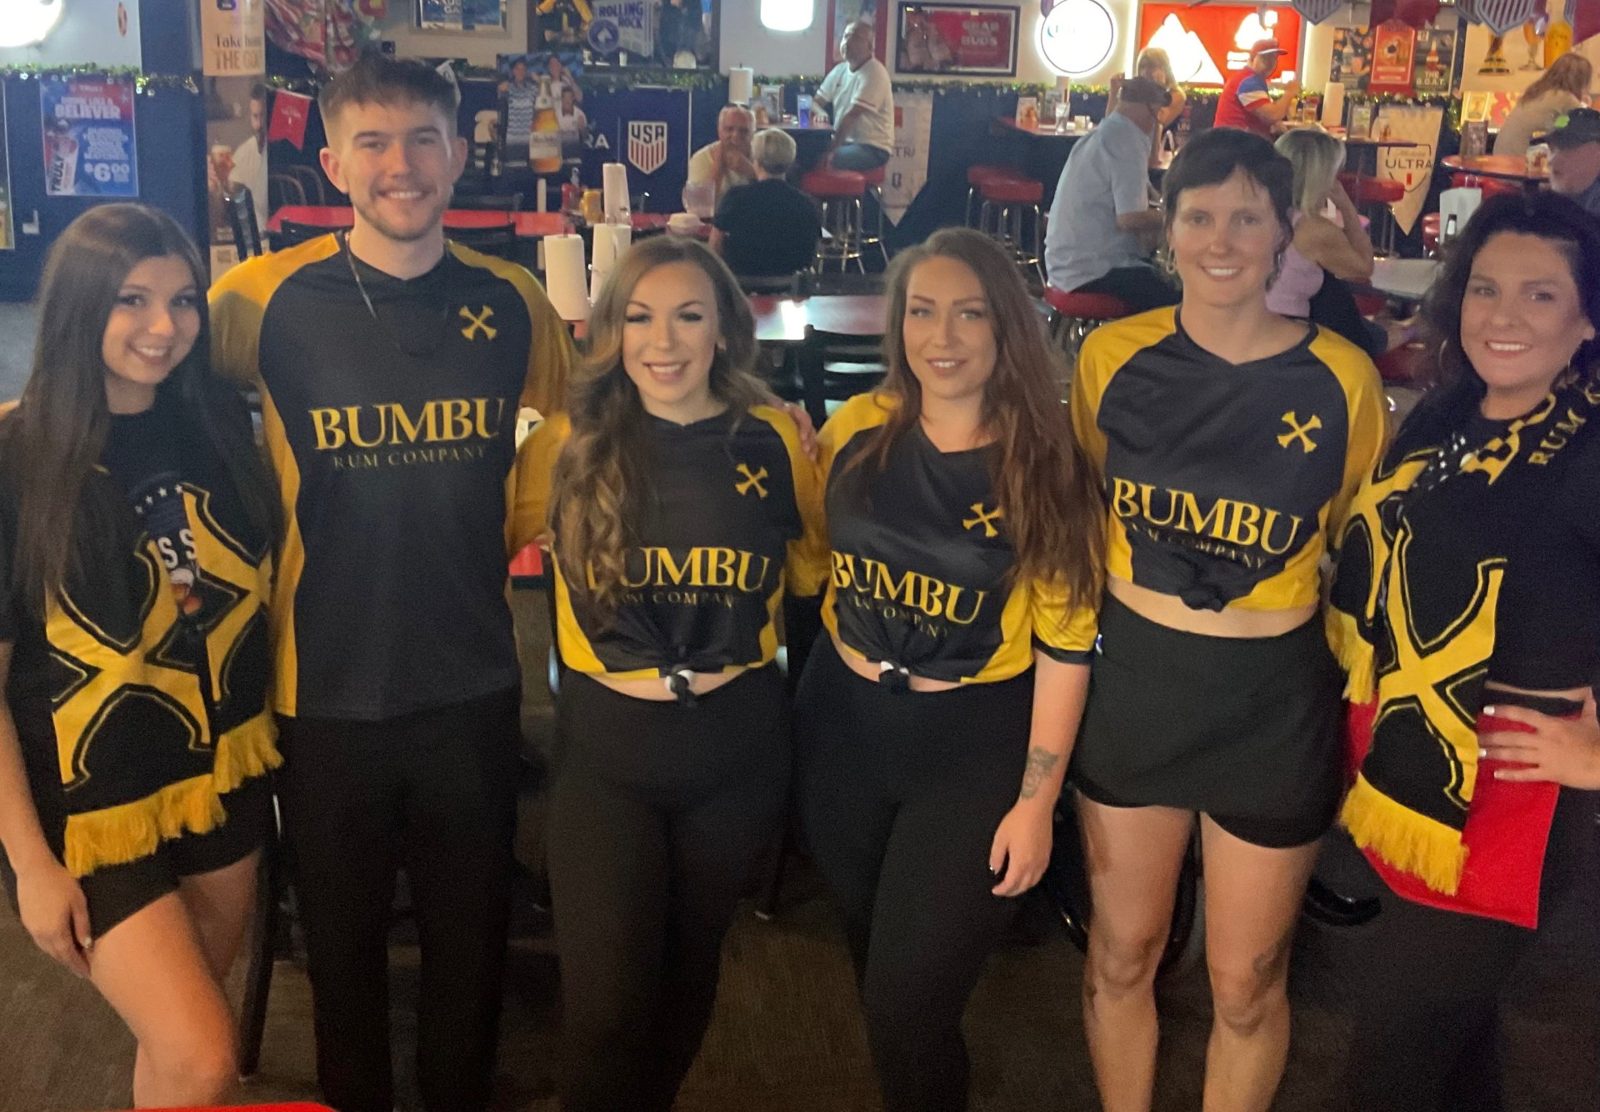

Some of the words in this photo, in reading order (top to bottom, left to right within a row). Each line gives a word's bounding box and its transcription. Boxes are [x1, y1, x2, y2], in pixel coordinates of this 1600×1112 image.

[599, 1, 644, 17] ROLLING
[617, 15, 643, 29] ROCK
[212, 49, 240, 70] THE
[631, 124, 665, 145] USA
[50, 154, 66, 192] TRULY
[1385, 159, 1432, 169] ULTRA
[308, 398, 505, 450] BUMBU
[1528, 408, 1587, 465] RUM
[332, 453, 379, 469] RUM
[387, 445, 486, 466] COMPANY
[1112, 477, 1303, 555] BUMBU
[586, 546, 771, 592] UMBU
[831, 550, 988, 625] BUMBU
